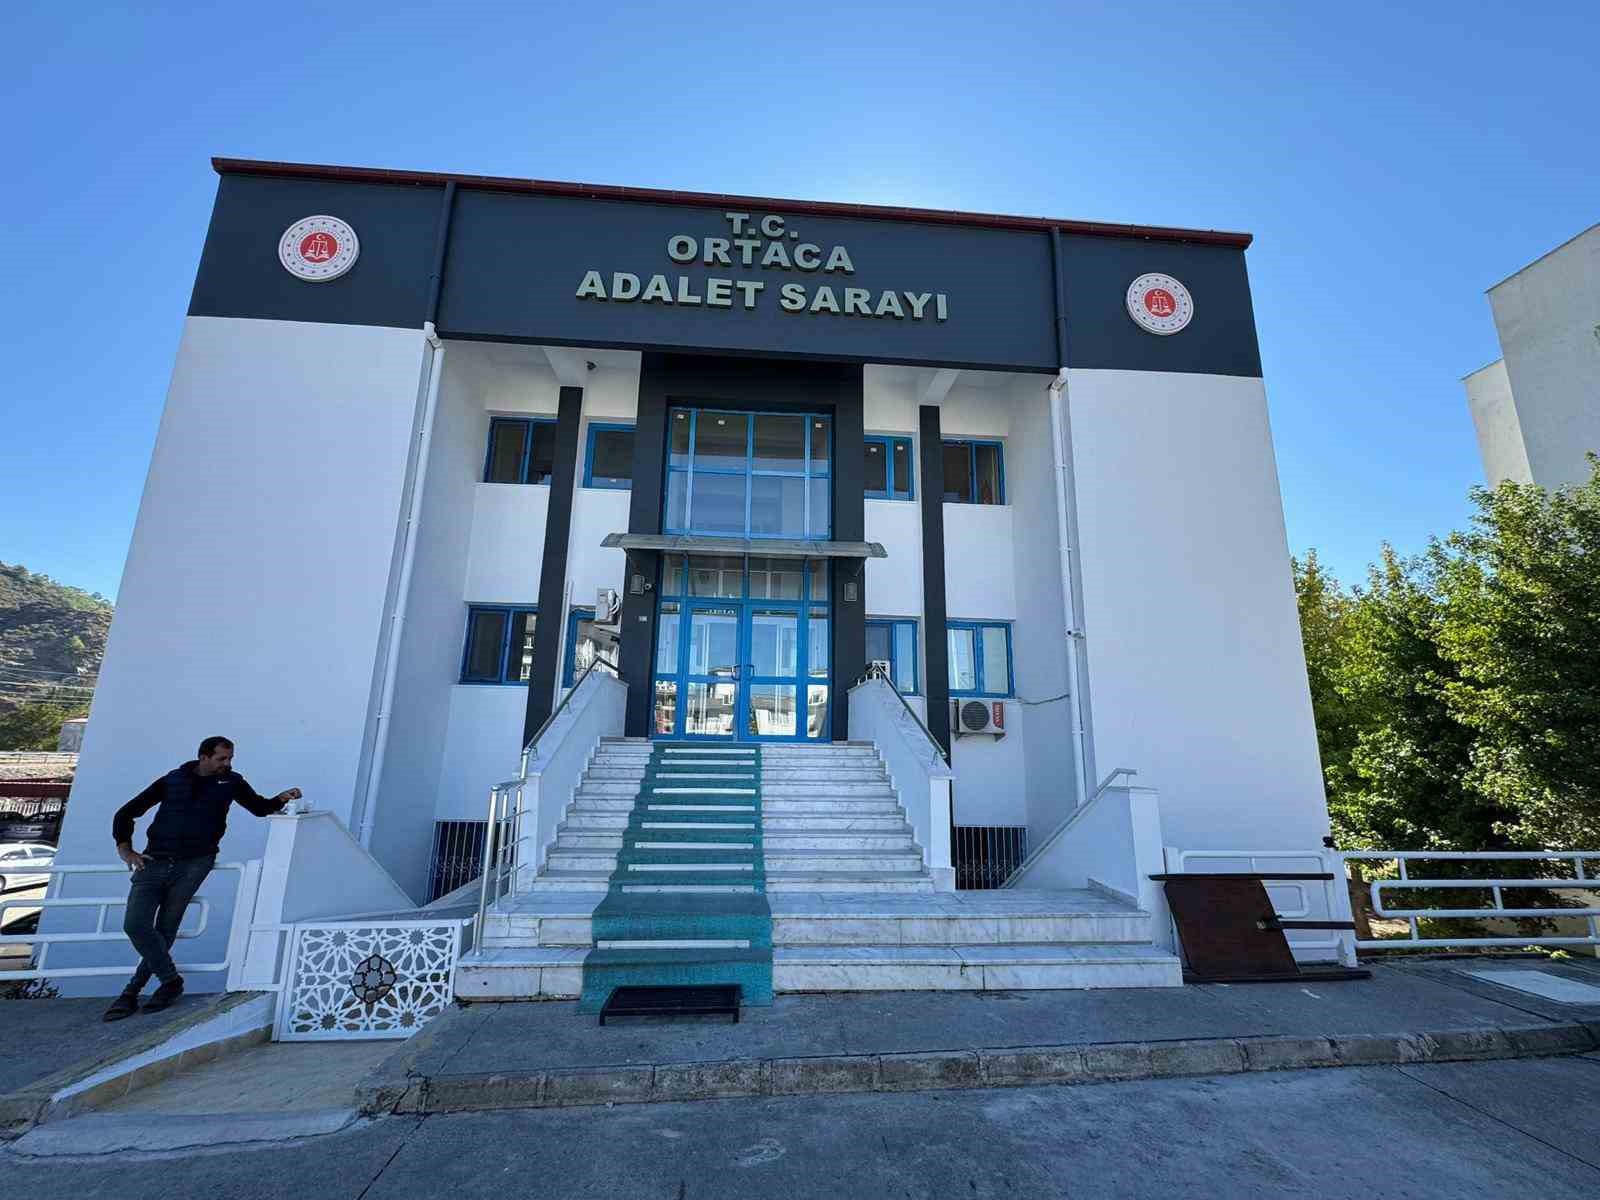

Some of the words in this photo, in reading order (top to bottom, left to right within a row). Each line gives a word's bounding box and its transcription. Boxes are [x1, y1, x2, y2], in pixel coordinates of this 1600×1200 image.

[726, 212, 798, 239] T.C.
[667, 235, 855, 273] ORTACA
[575, 270, 764, 308] ADALET
[780, 283, 949, 321] SARAYI
